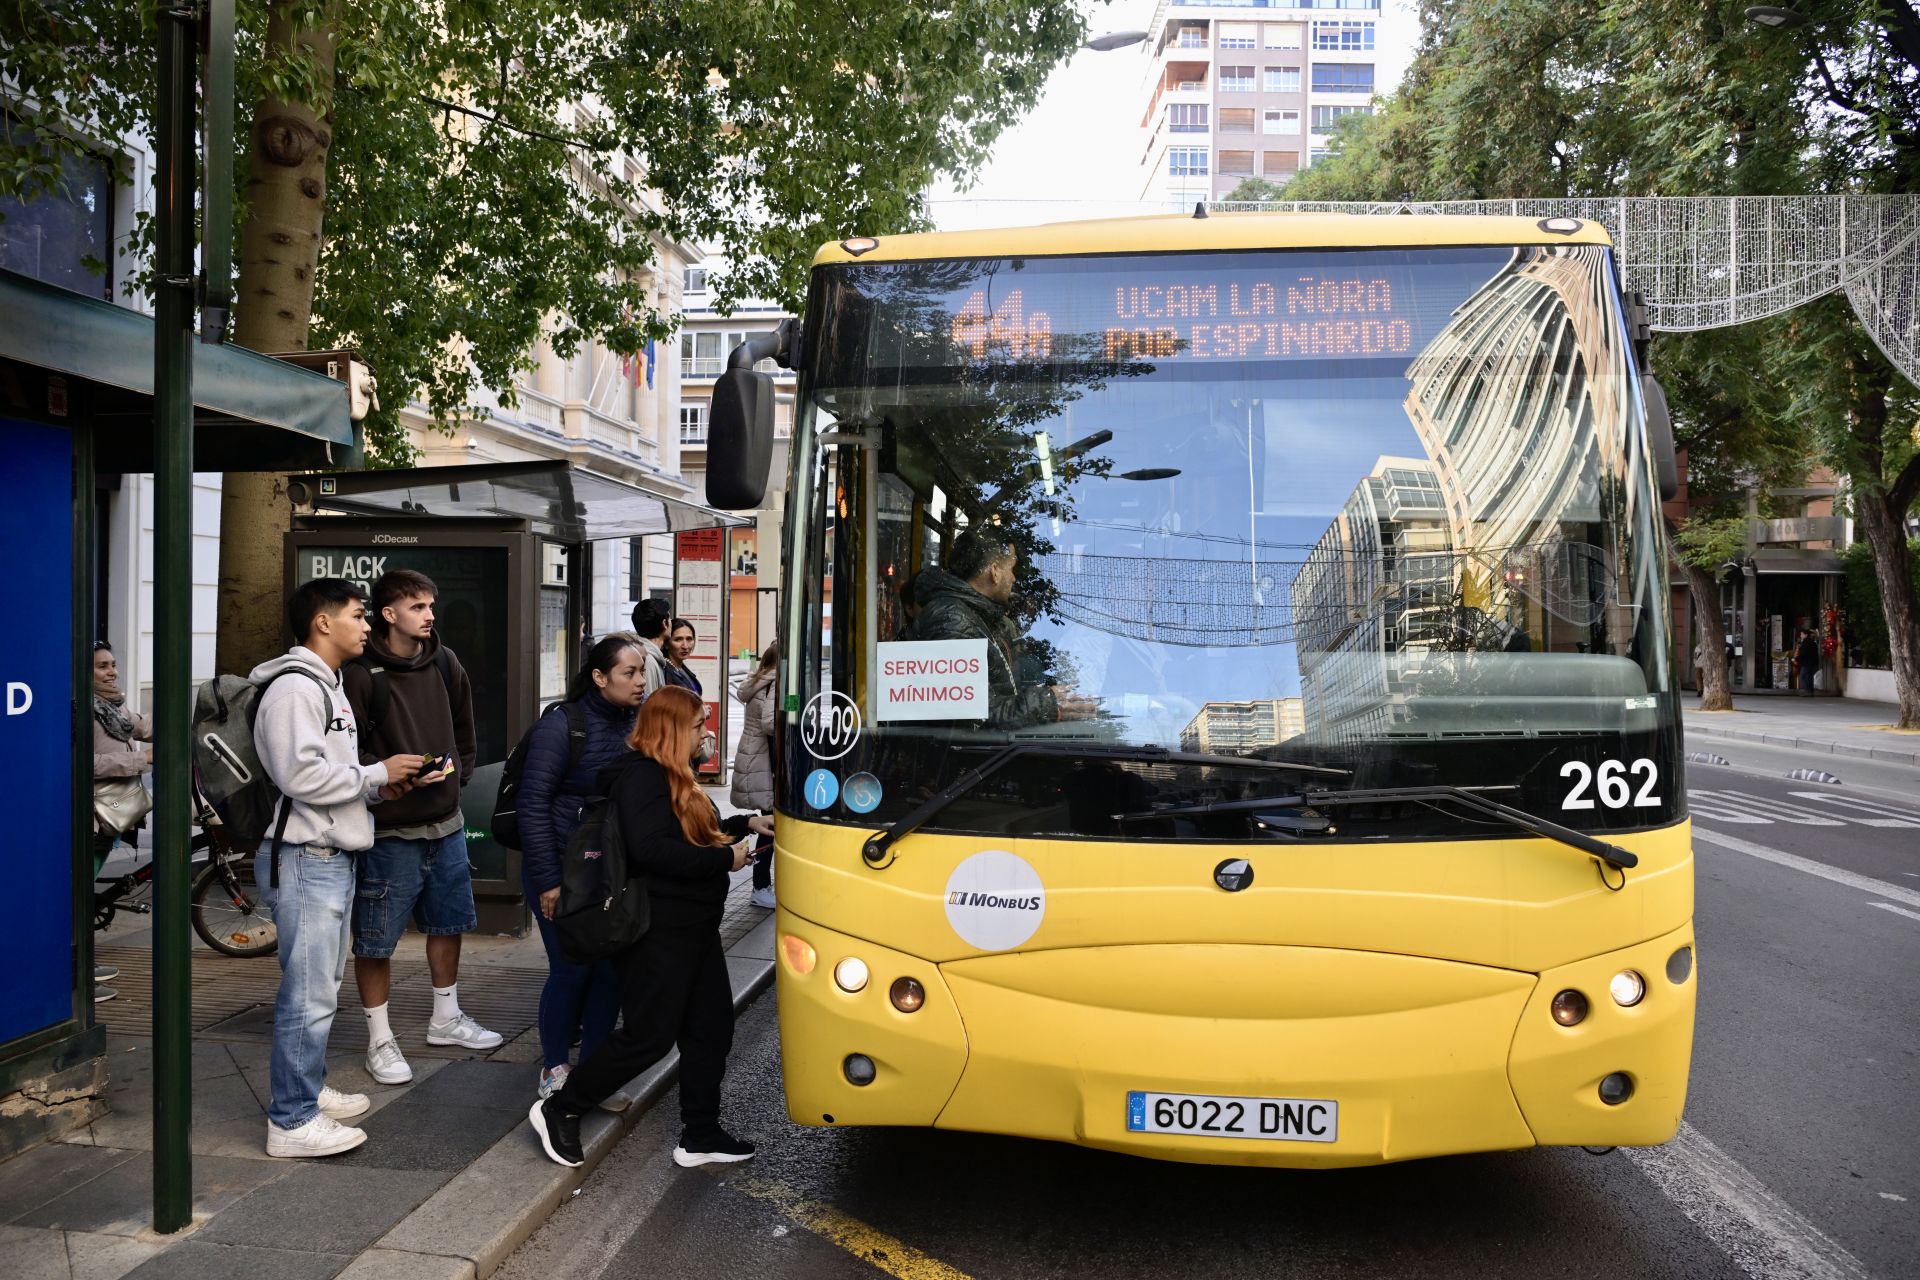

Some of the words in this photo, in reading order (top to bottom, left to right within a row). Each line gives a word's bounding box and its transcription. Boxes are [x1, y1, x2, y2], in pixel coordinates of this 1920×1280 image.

[1116, 284, 1217, 318] UCAM
[1230, 282, 1275, 316] LA
[1288, 276, 1391, 314] ÑORA
[1106, 325, 1178, 360] POR
[1191, 319, 1411, 358] ESPINARDO
[372, 534, 418, 544] JCDecaux
[311, 555, 388, 579] BLACK
[884, 658, 980, 676] SERVICIOS
[7, 681, 33, 715] D
[889, 685, 975, 703] MÍNIMOS
[1560, 758, 1662, 810] 262
[968, 892, 1041, 911] MONBUS
[1133, 1115, 1141, 1125] E
[1154, 1098, 1245, 1132] 6022
[1259, 1102, 1328, 1136] DNC
